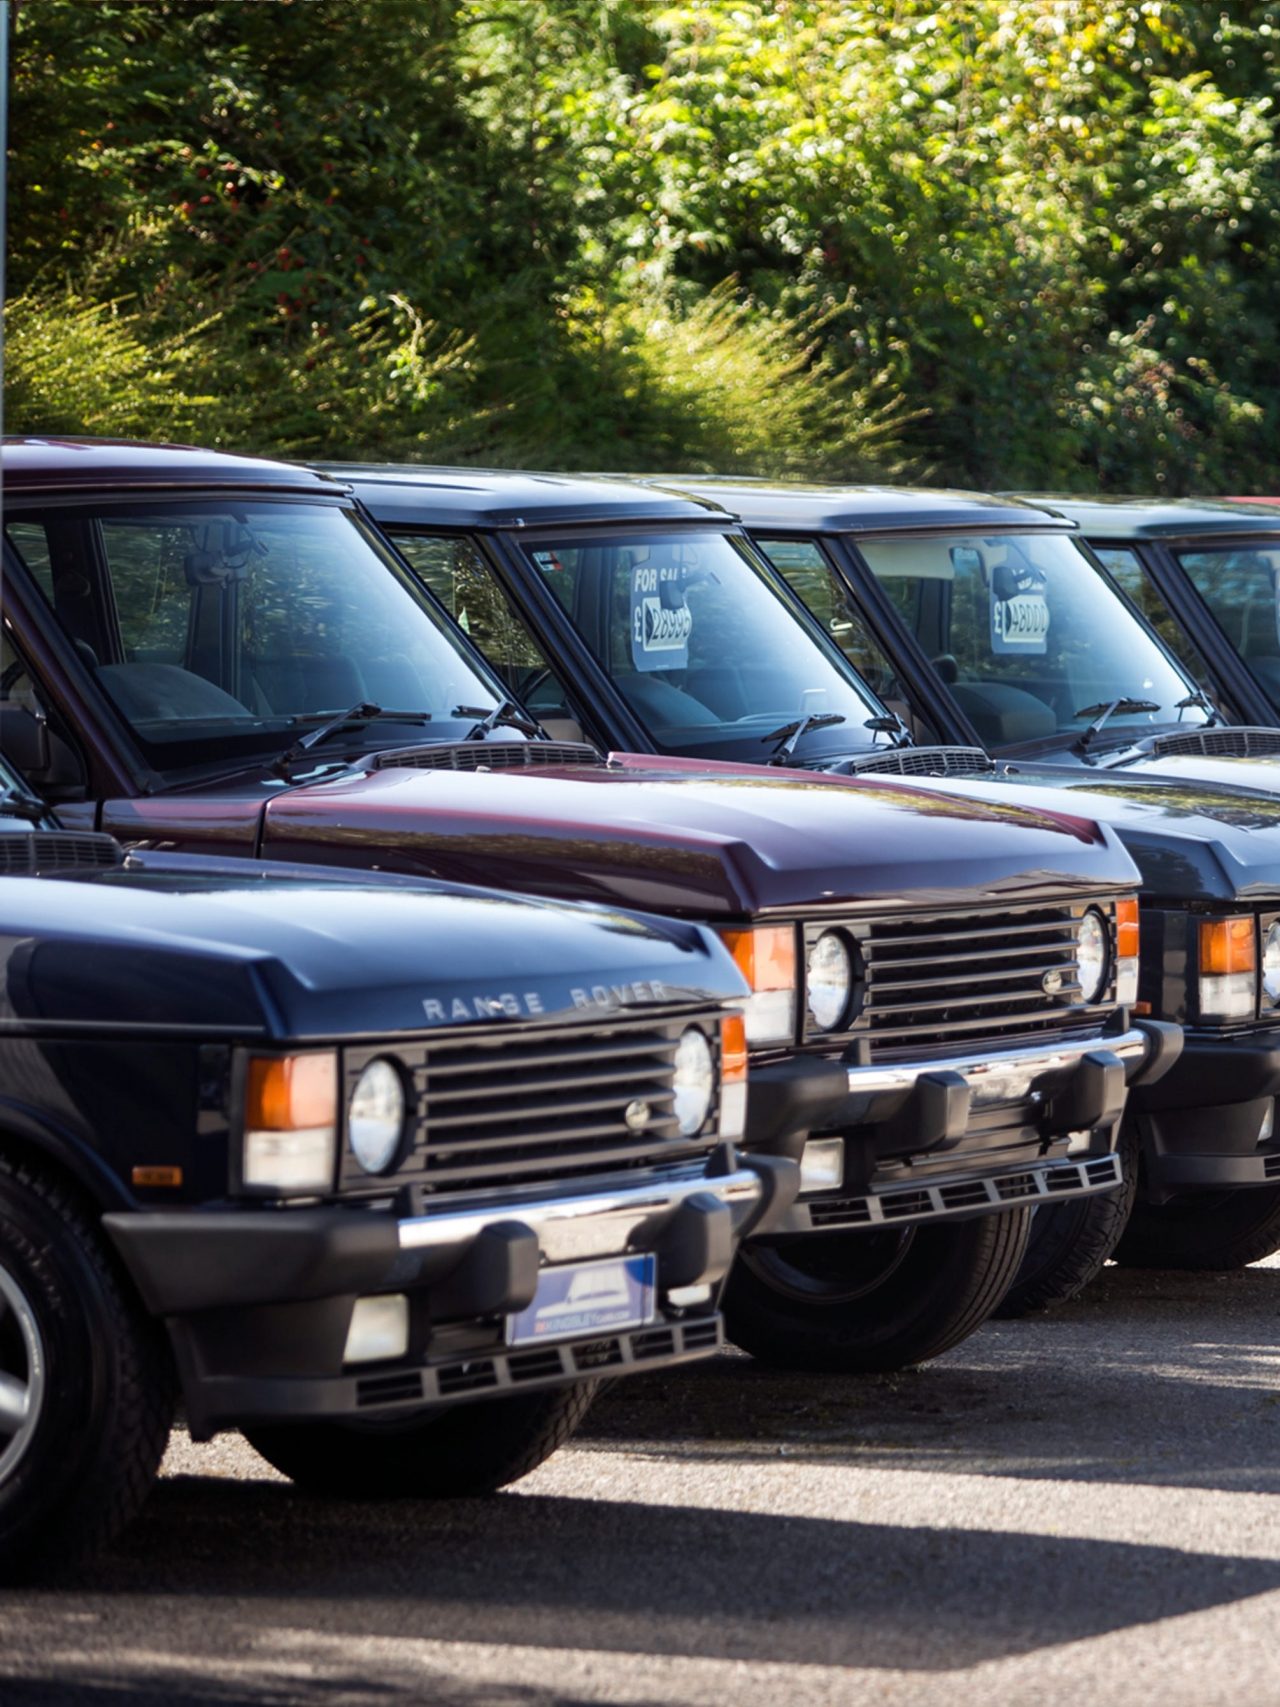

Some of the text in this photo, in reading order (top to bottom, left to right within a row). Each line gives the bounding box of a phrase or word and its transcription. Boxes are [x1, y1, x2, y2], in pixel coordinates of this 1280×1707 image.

[634, 568, 657, 592] FOR
[422, 979, 667, 1021] RANGE ROVER
